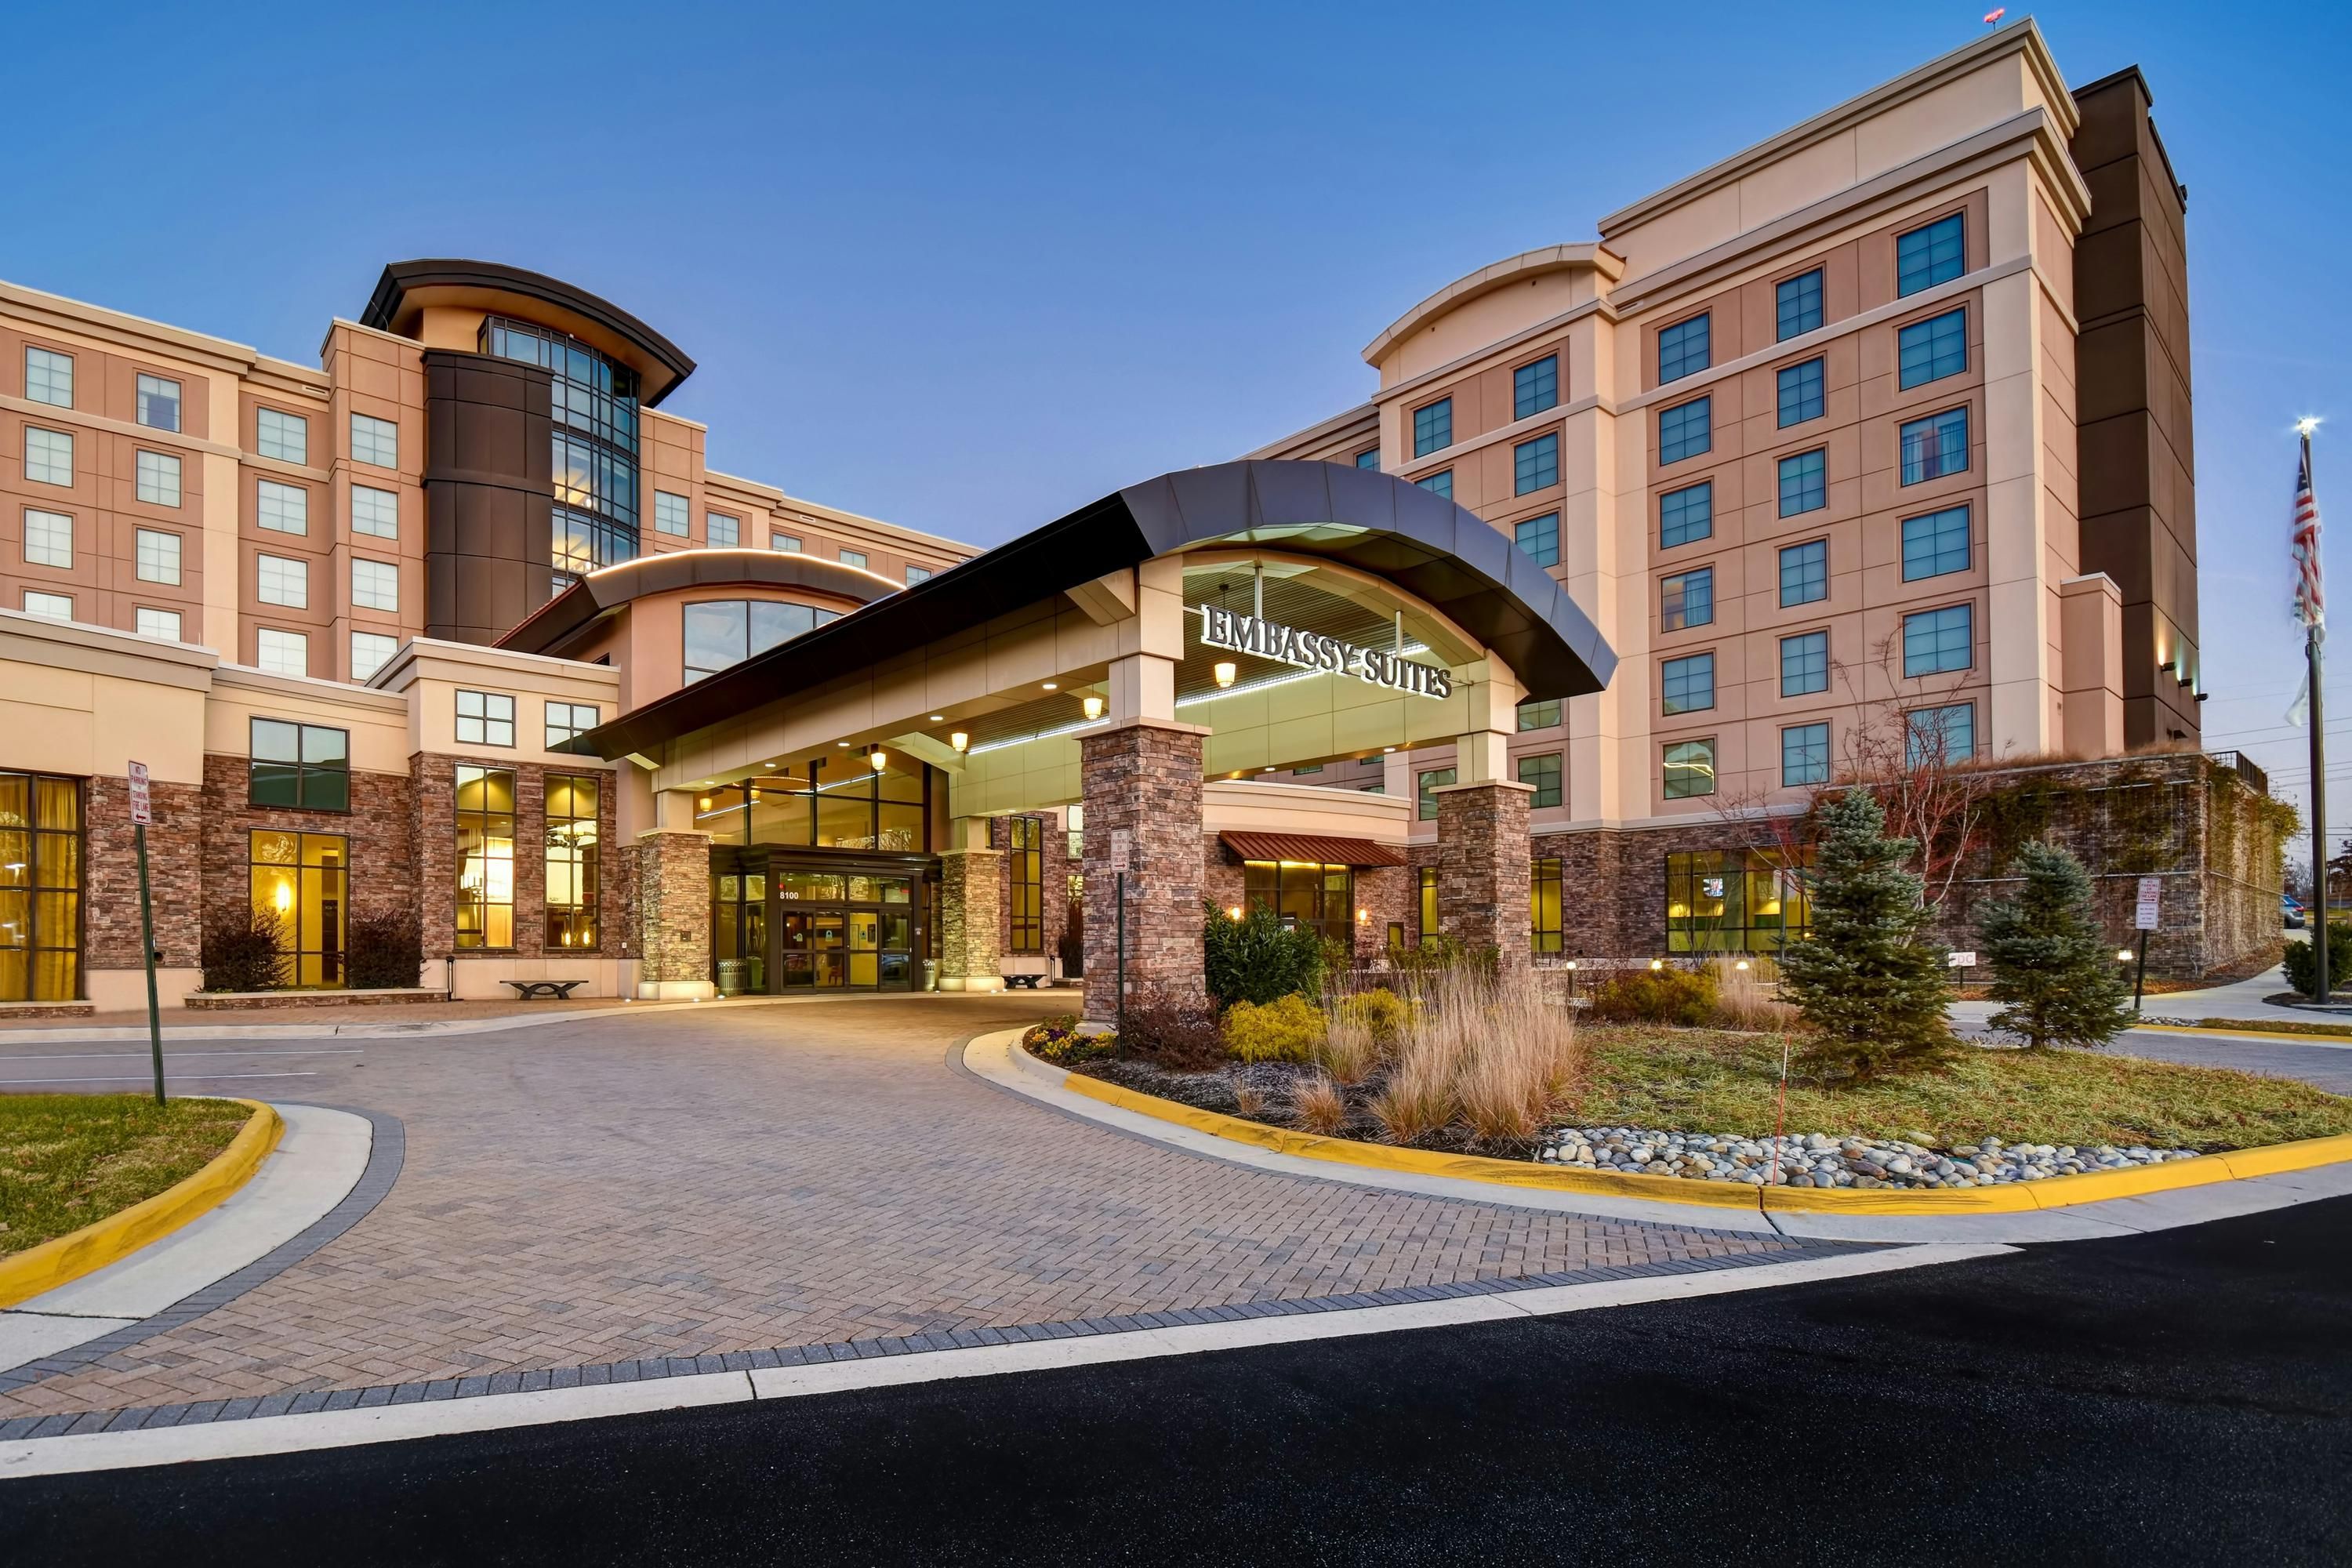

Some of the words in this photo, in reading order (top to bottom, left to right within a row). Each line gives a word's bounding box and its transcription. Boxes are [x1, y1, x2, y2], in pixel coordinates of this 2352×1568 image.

[1201, 604, 1356, 676] EMBASSY
[1362, 648, 1452, 700] SUITES
[131, 775, 147, 786] PARKING
[132, 790, 147, 800] STANDING
[1951, 955, 1973, 964] FDC
